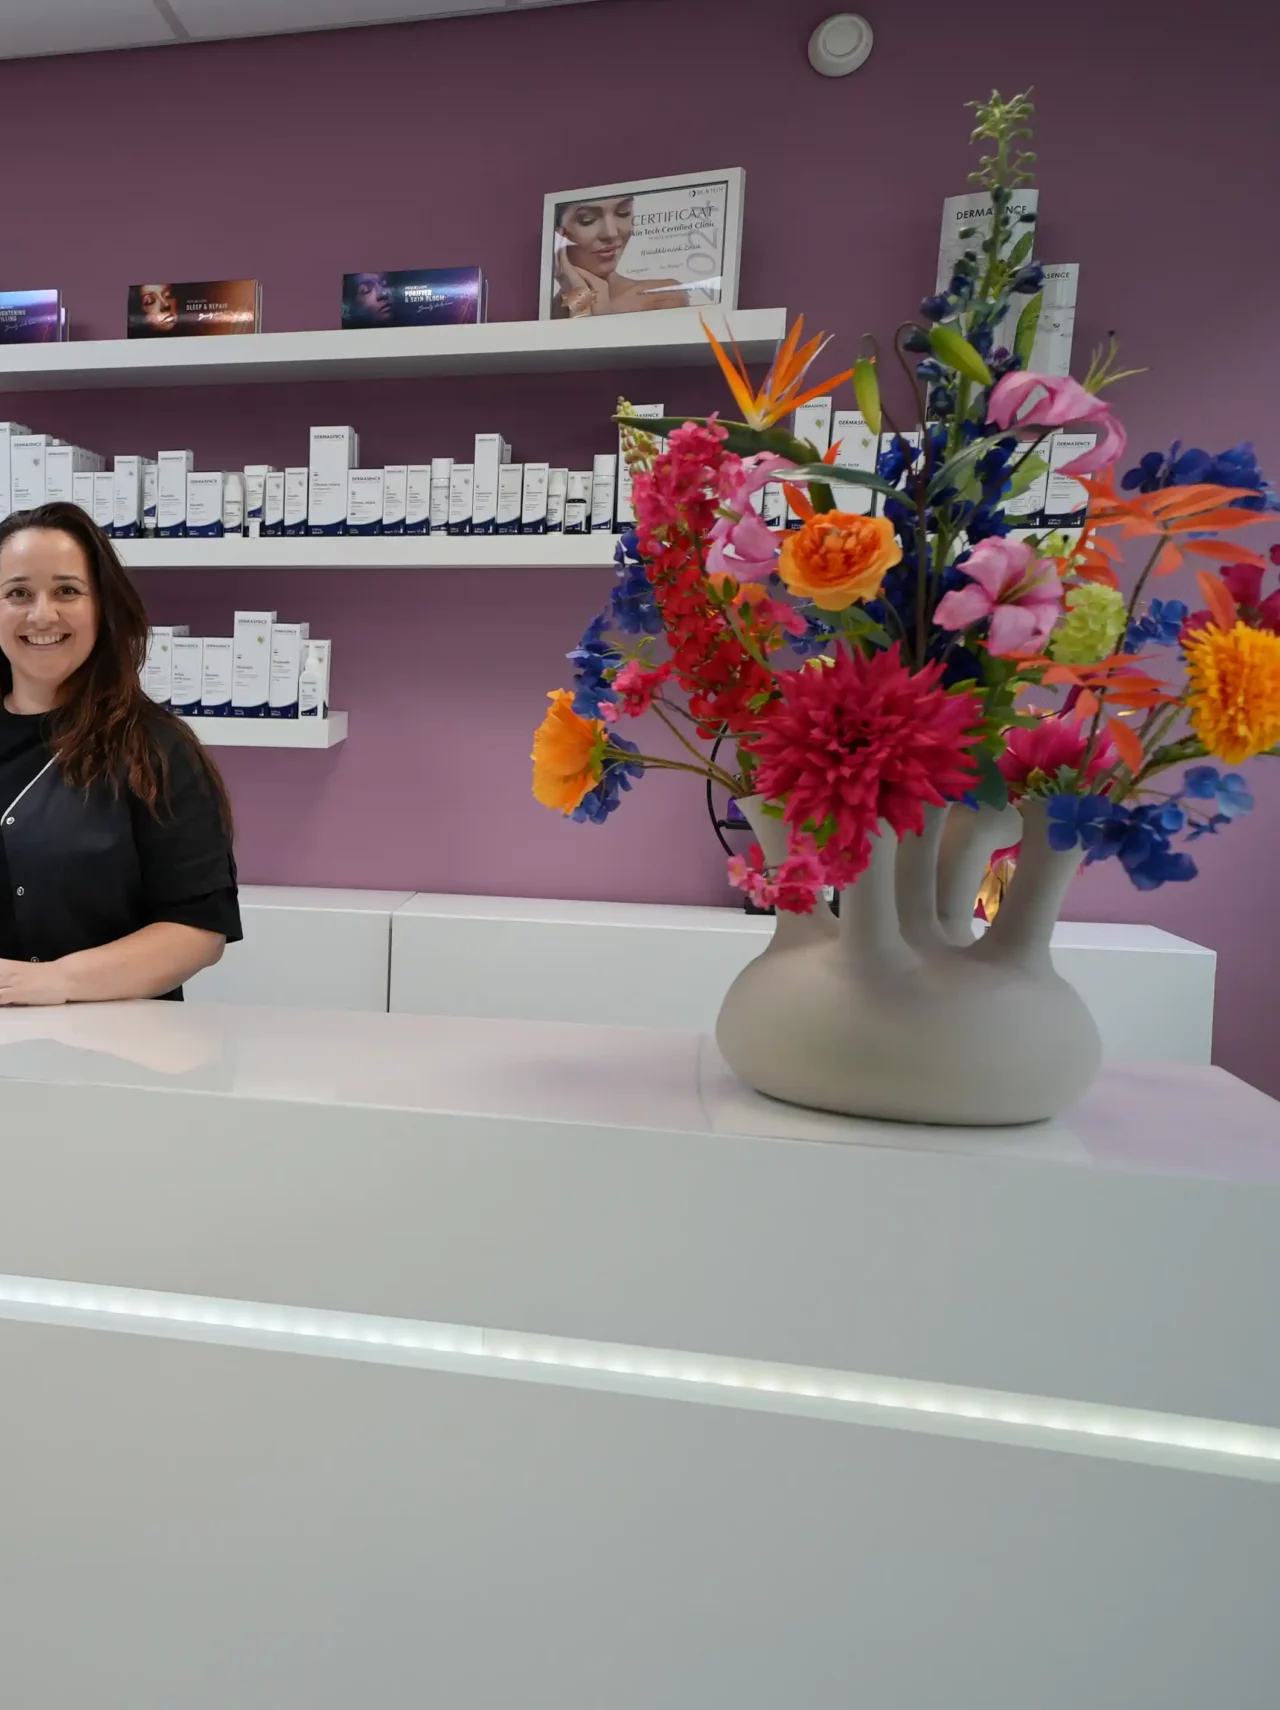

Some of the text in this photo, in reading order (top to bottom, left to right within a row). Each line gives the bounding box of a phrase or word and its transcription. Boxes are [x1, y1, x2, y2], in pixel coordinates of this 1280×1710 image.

[630, 205, 714, 227] CERTIFICAAT
[956, 205, 1027, 220] DERMANCE
[644, 226, 660, 236] Tech
[661, 222, 693, 233] Certified
[694, 220, 715, 230] Clinic
[186, 303, 202, 311] SLEEP
[209, 302, 228, 310] REPAIR
